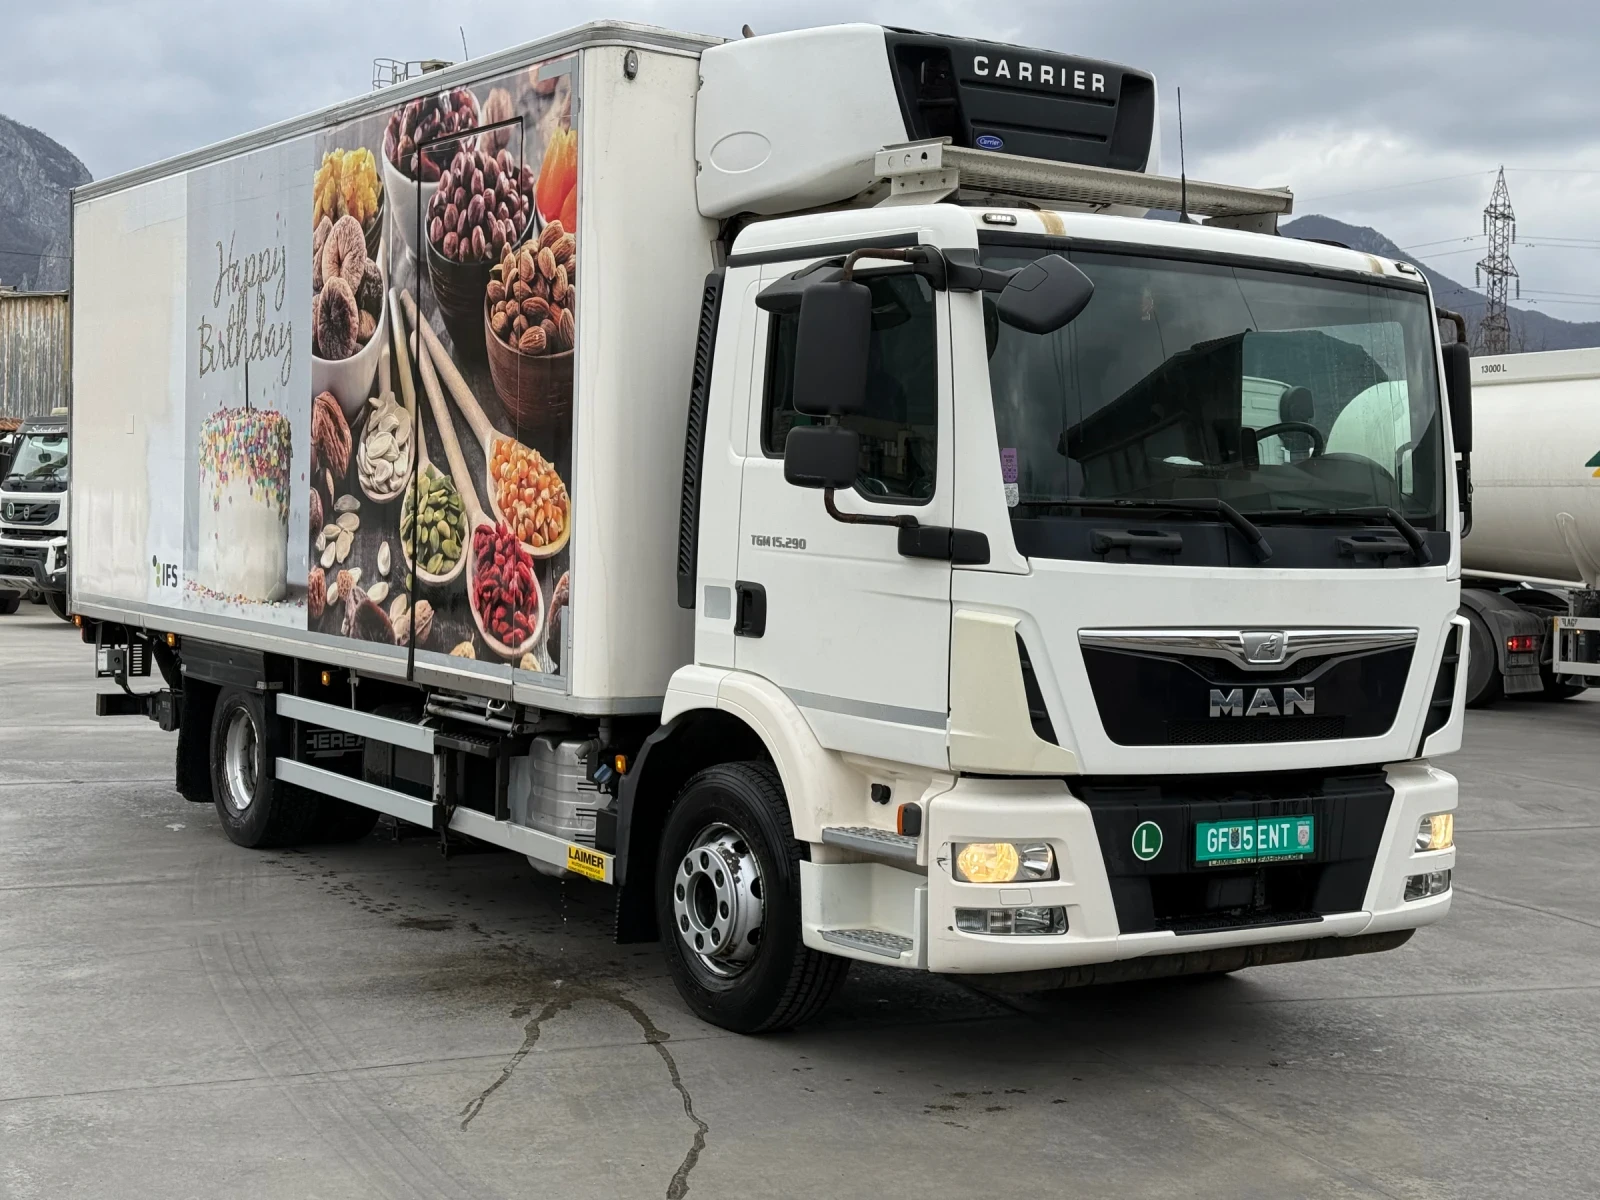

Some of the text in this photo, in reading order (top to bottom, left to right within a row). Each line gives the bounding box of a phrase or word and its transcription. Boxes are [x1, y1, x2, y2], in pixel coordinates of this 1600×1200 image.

[973, 55, 1105, 93] CARRIER
[979, 138, 1000, 146] Carrier
[213, 230, 286, 316] Happy
[197, 301, 292, 386] Birthday
[1481, 363, 1507, 373] 13000 L
[751, 534, 807, 550] TGM 15.290
[162, 563, 178, 588] IFS
[1209, 687, 1315, 718] MAN
[1141, 829, 1154, 853] L
[1207, 828, 1229, 852] GF
[568, 847, 604, 869] LAIMER
